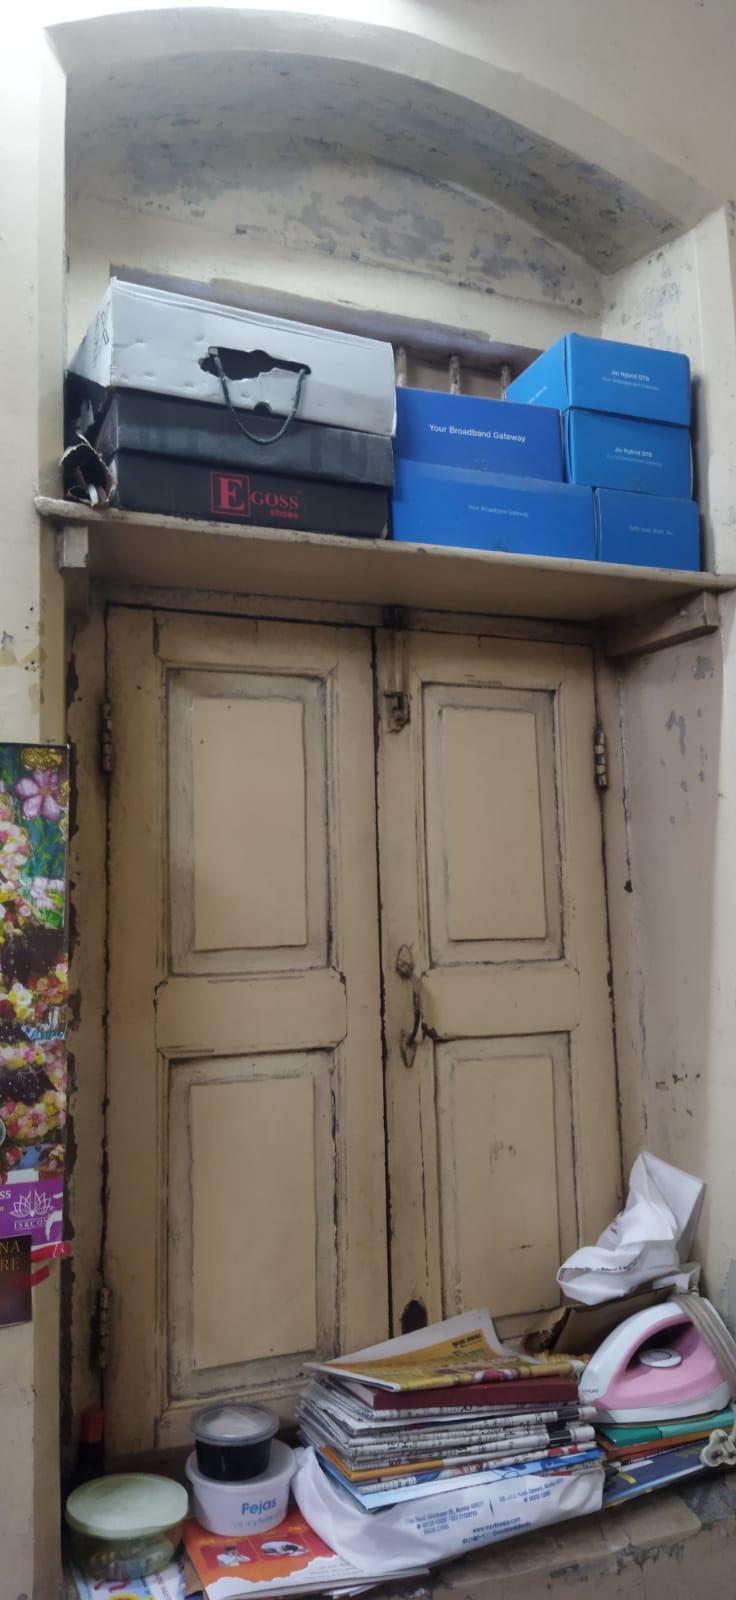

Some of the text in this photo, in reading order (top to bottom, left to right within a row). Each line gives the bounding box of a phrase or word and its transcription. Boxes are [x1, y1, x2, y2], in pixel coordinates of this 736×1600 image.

[429, 423, 526, 443] Your Broadband Gateway
[269, 508, 300, 520] shoes
[241, 1497, 277, 1515] Pejas
